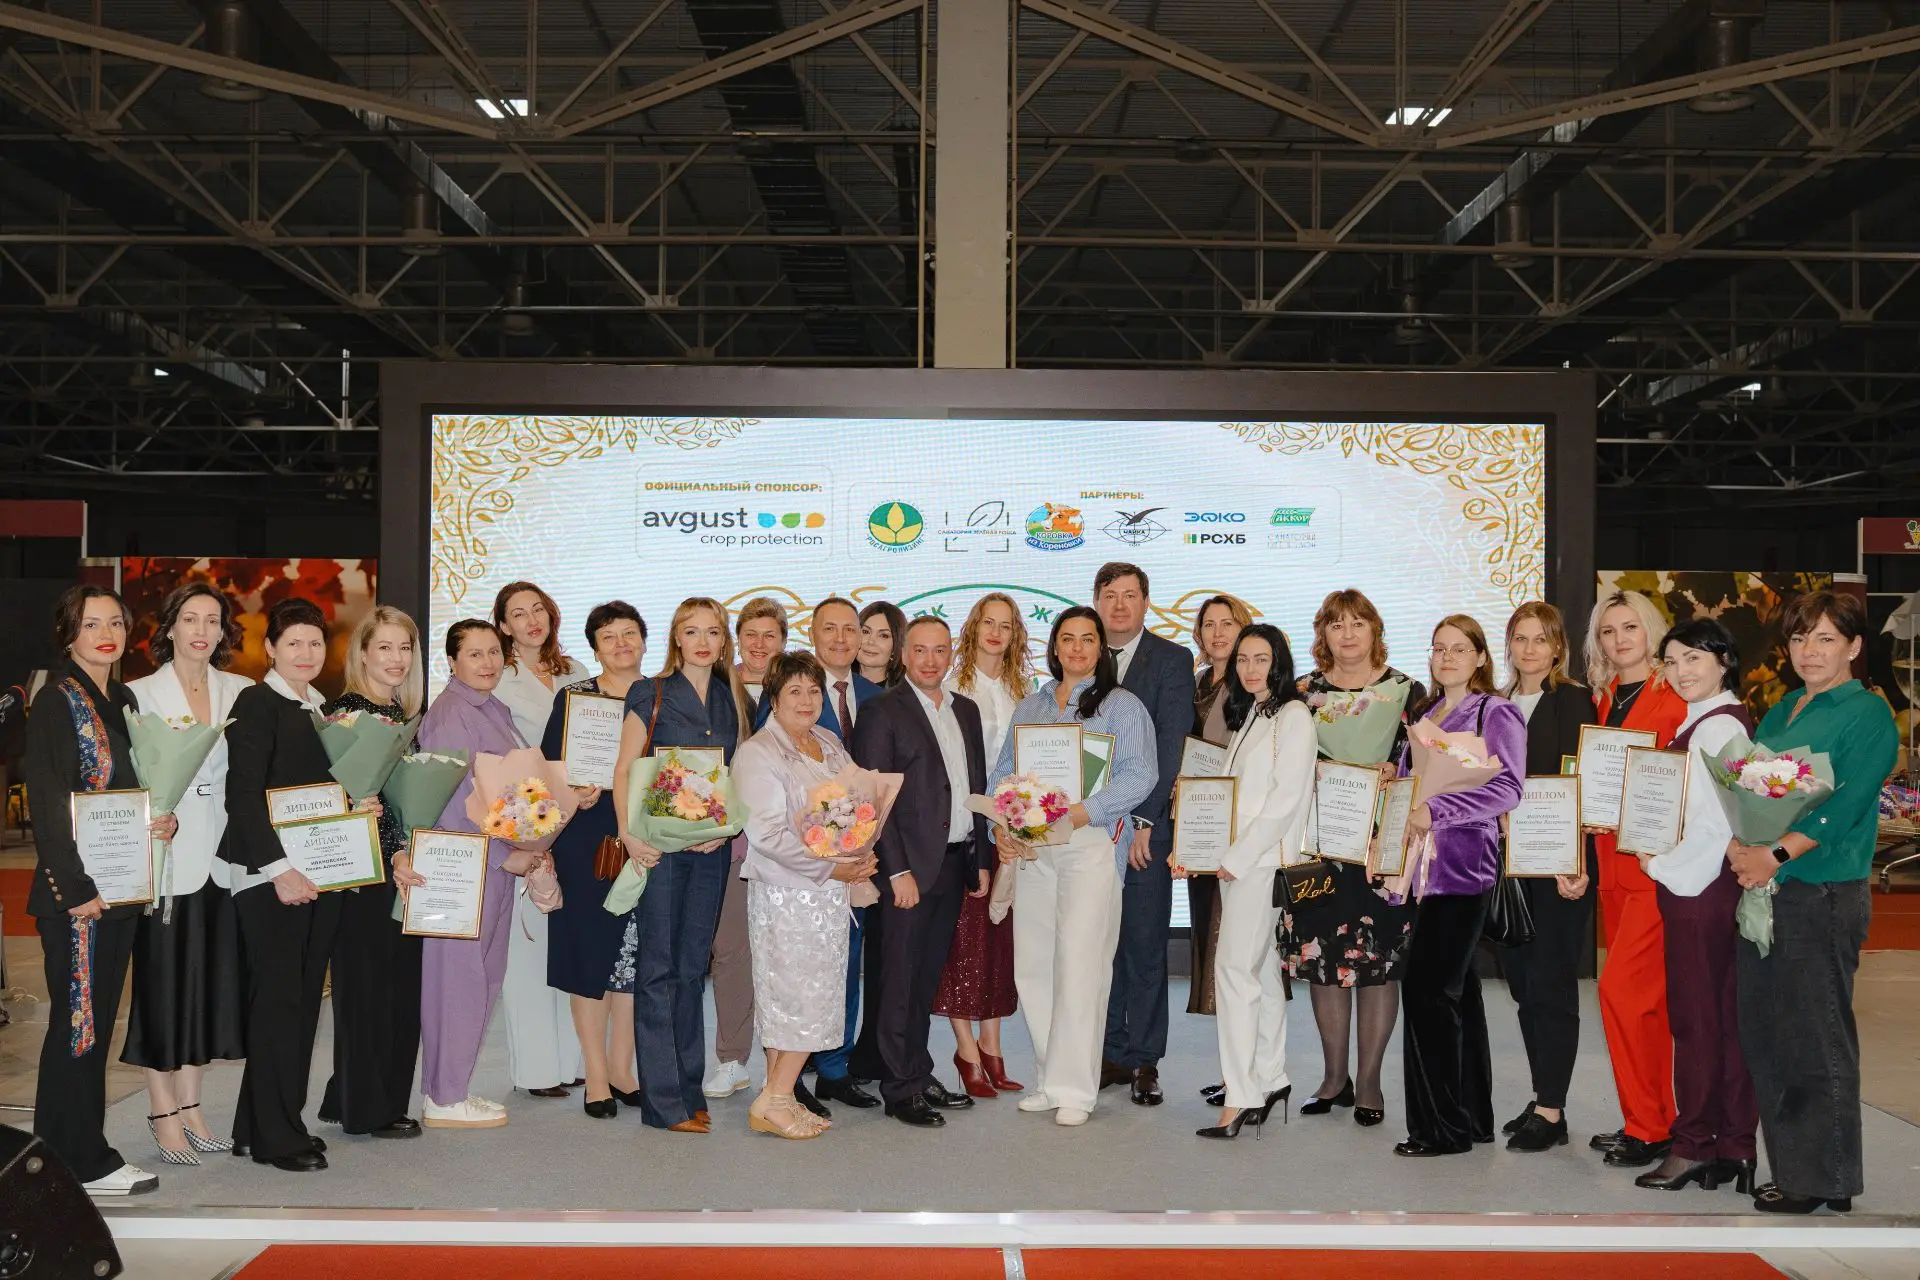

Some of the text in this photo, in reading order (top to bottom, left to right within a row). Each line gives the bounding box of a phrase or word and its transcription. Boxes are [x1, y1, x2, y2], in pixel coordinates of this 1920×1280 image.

[644, 481, 823, 492] ОФИЦИАЛЬНЫЙ СПОНСОР:
[1080, 490, 1144, 499] ПАРТНЁРЫ:
[643, 508, 748, 533] avgust
[1184, 512, 1246, 522] ЭФКО
[700, 533, 823, 547] crop protection
[866, 535, 925, 553] РОСАГРОЛИЗИНГ
[1039, 538, 1083, 550] Кореновки
[1200, 534, 1246, 544] РСХБ
[579, 708, 620, 720] ДИПЛОМ
[1637, 764, 1677, 777] ДИПЛОМ
[1325, 776, 1368, 790] ДИПЛОМ
[1189, 793, 1226, 802] ДИПЛОМ
[283, 800, 333, 815] ДИПЛОМ
[88, 809, 136, 821] ДИПЛОМ
[304, 834, 349, 848] ДИПЛОМ
[425, 847, 473, 858] ДИПЛОМ
